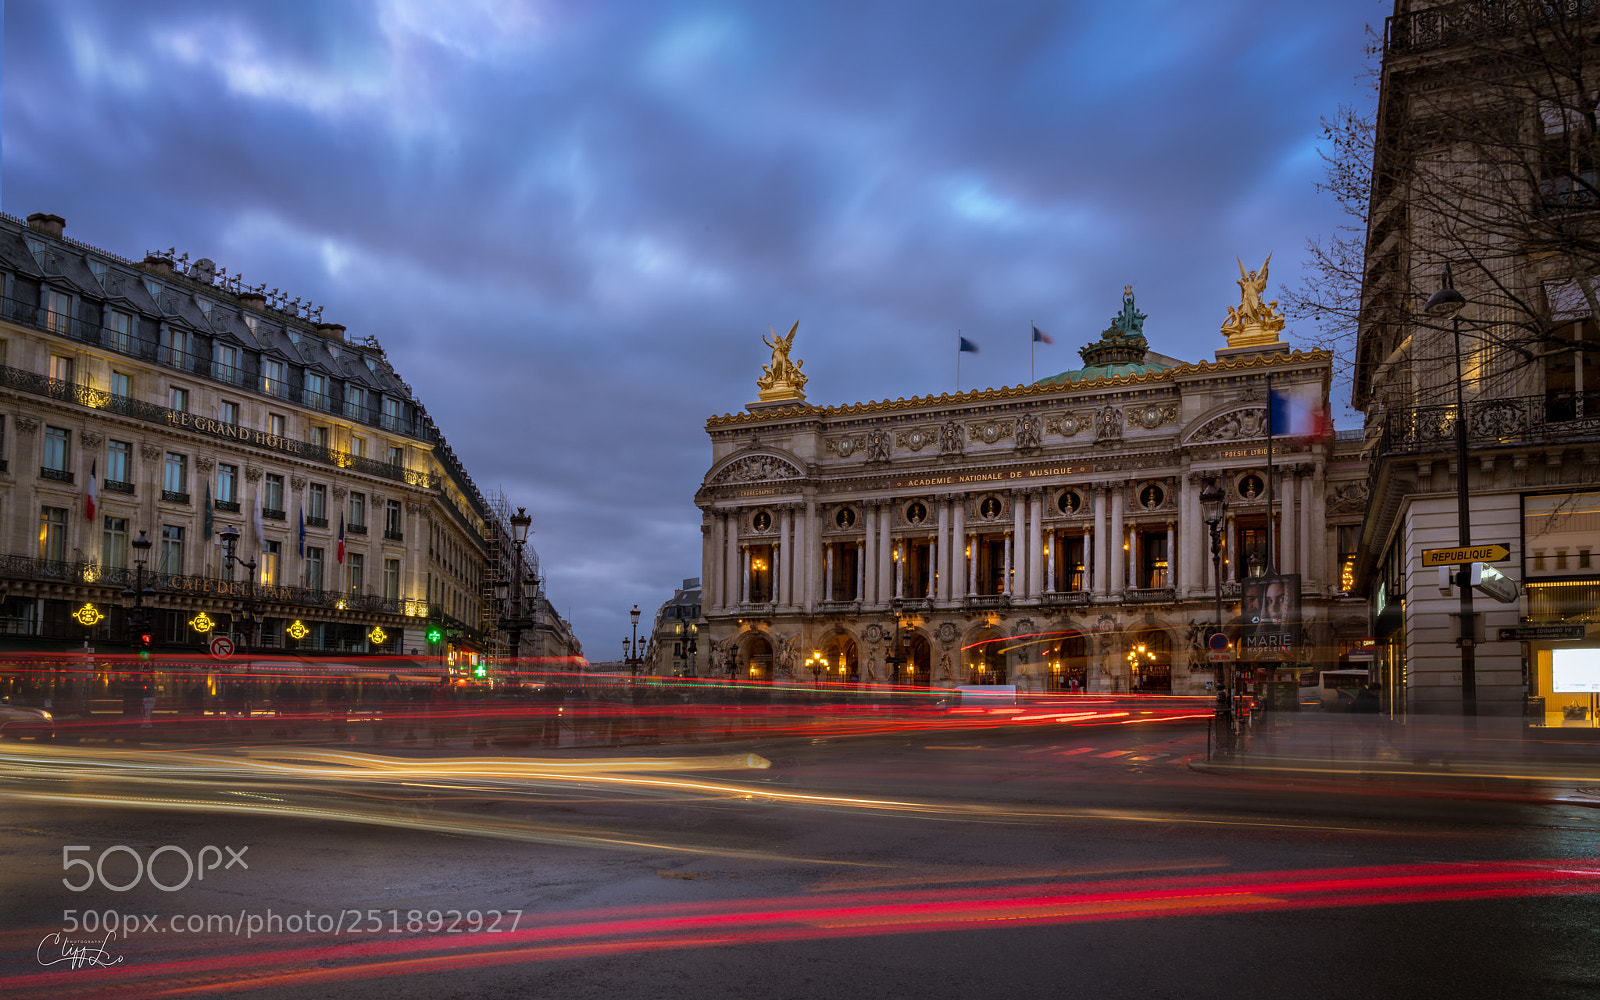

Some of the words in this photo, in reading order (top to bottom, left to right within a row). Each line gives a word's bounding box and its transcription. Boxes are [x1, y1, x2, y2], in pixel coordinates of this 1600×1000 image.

[172, 410, 188, 426] LE
[195, 417, 250, 440] GRAND
[1251, 448, 1276, 456] LYRIQE
[908, 476, 951, 486] ACADEMIE
[959, 473, 1002, 482] NATIONALE
[1029, 467, 1072, 477] MUSIQUE
[1431, 548, 1493, 562] REPUBLIQUE
[217, 581, 237, 595] DE
[1247, 634, 1292, 647] MARIE
